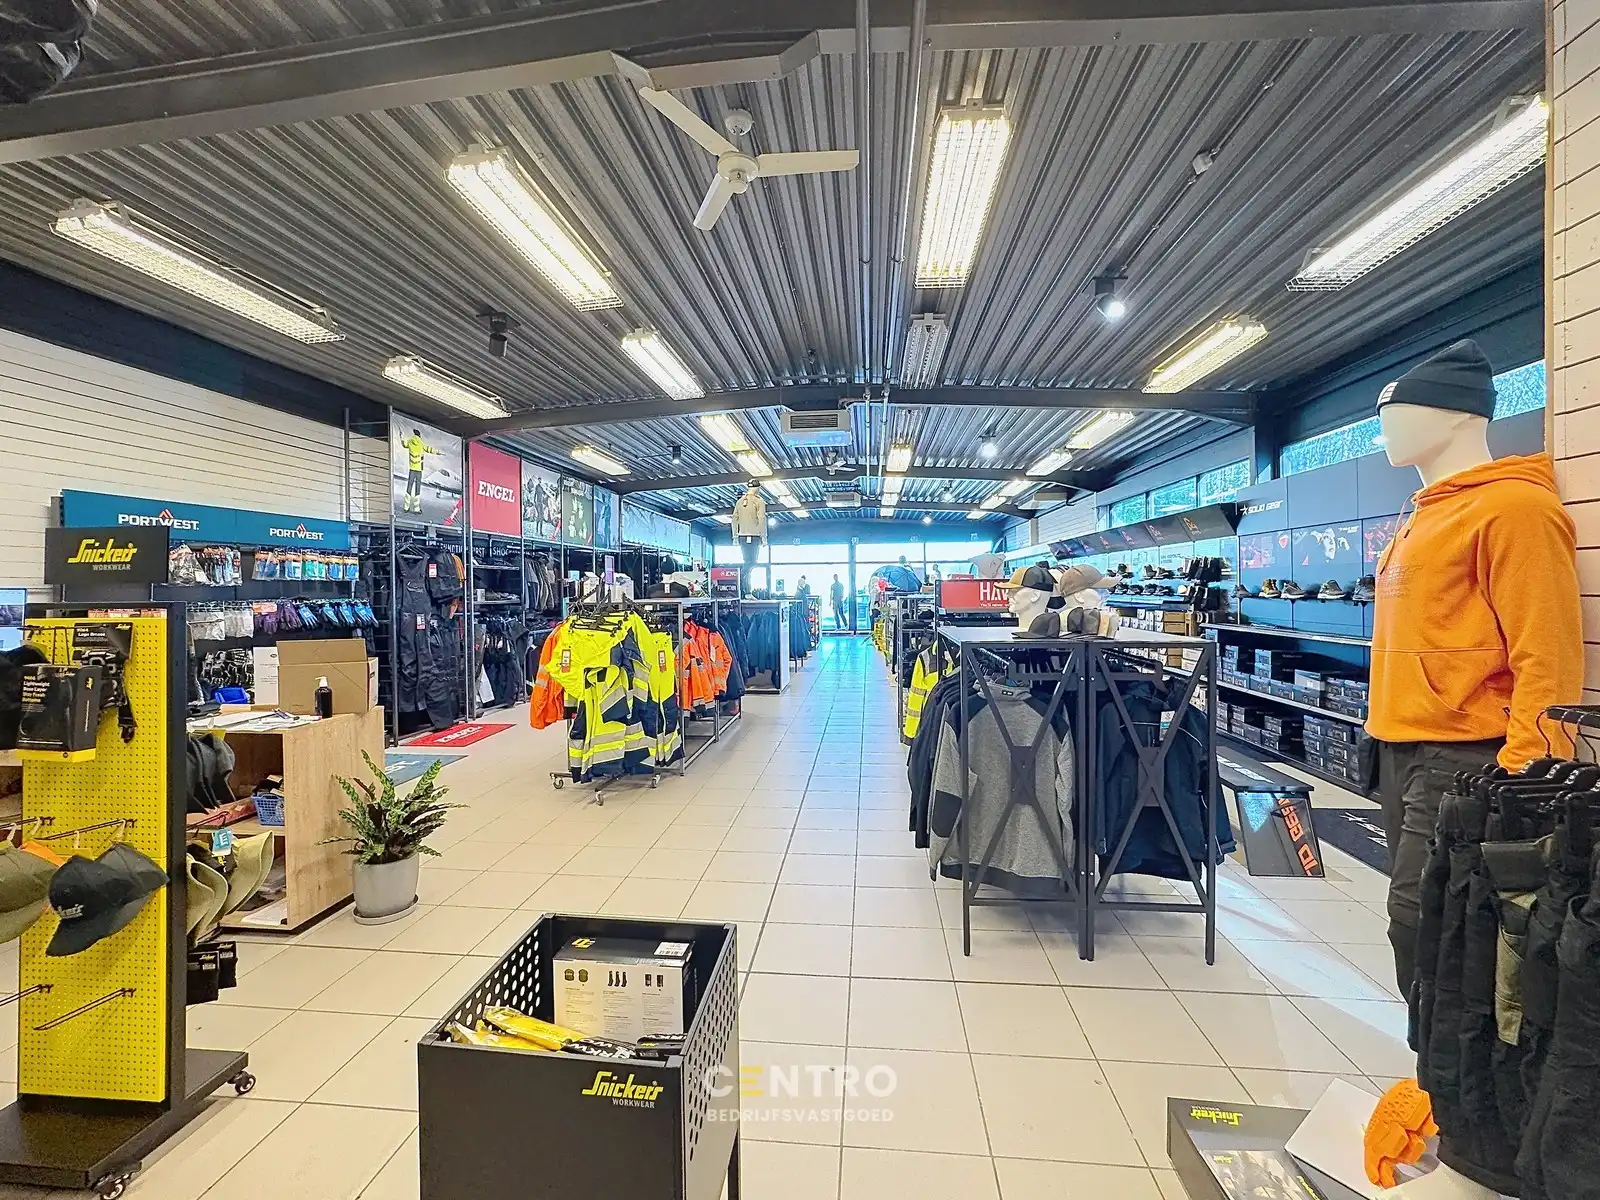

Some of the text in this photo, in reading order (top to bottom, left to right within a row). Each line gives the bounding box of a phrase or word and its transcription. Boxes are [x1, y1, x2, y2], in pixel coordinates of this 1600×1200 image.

[478, 480, 515, 503] ENGEL
[118, 513, 200, 531] PORTWEST
[269, 527, 324, 541] PORTWEST
[67, 538, 138, 564] Snickers
[92, 564, 132, 572] WORKWEAR
[581, 1070, 664, 1097] Snickers
[612, 1098, 655, 1109] WORKWEAR
